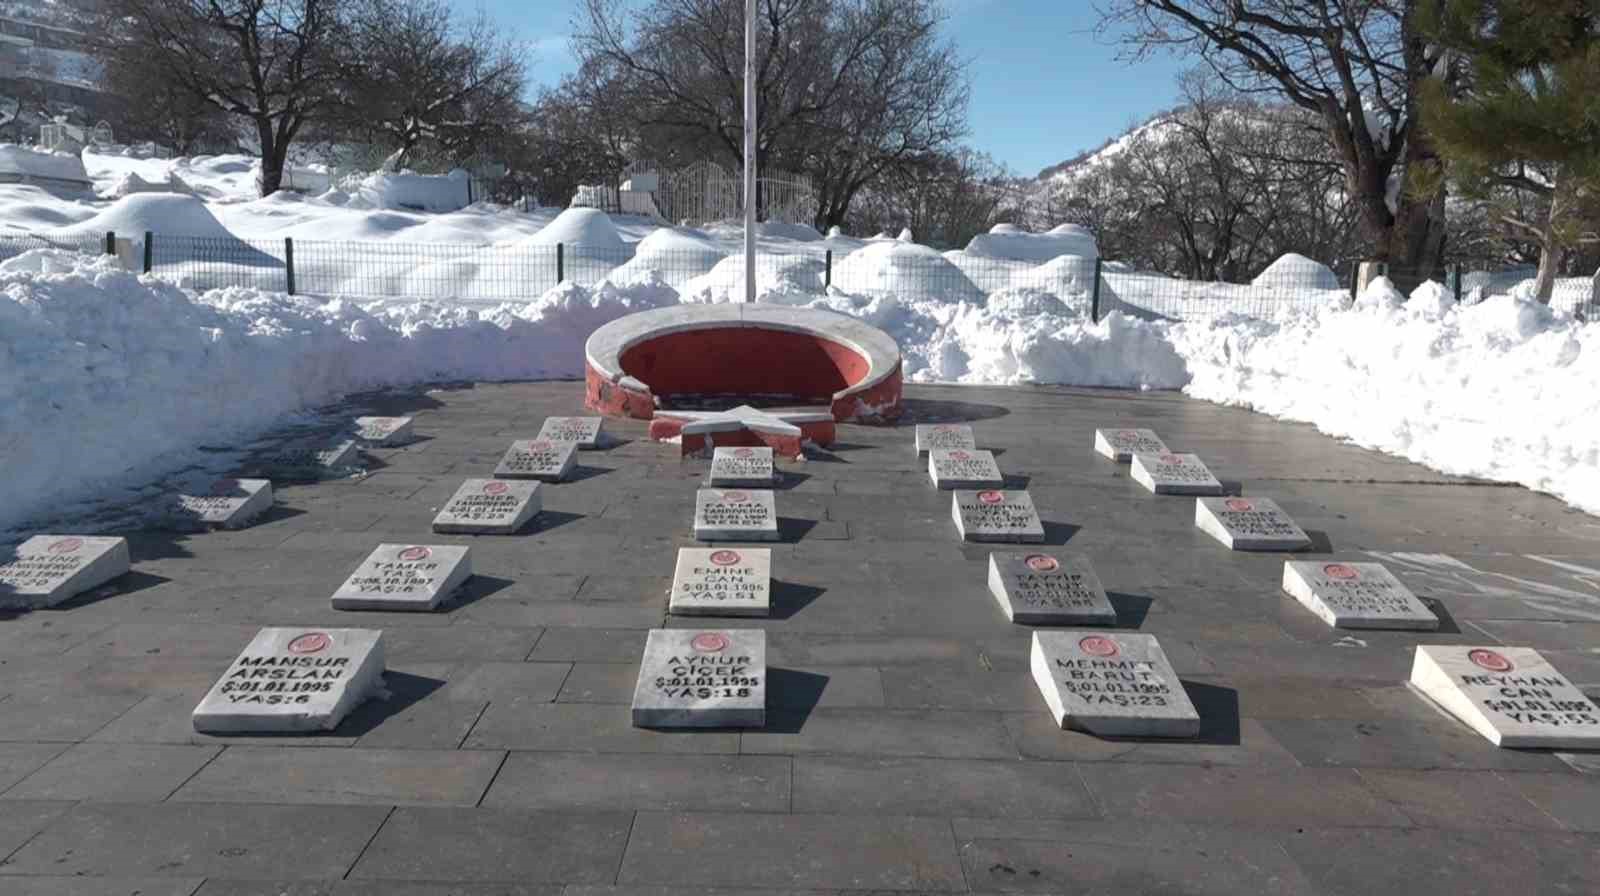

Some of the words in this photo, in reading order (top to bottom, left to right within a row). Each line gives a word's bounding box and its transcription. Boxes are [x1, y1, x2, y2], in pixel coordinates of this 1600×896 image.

[239, 656, 350, 668] MANSUR
[667, 655, 752, 665] AYNUR
[229, 668, 344, 680] ARSLAN
[1070, 671, 1151, 681] BARUT
[1460, 675, 1565, 687] REYHAN
[663, 688, 751, 700] YAŞ:18
[1499, 687, 1553, 699] CAN
[1079, 694, 1168, 707] YAŞ:23
[1505, 712, 1599, 726] YAŞ:55
